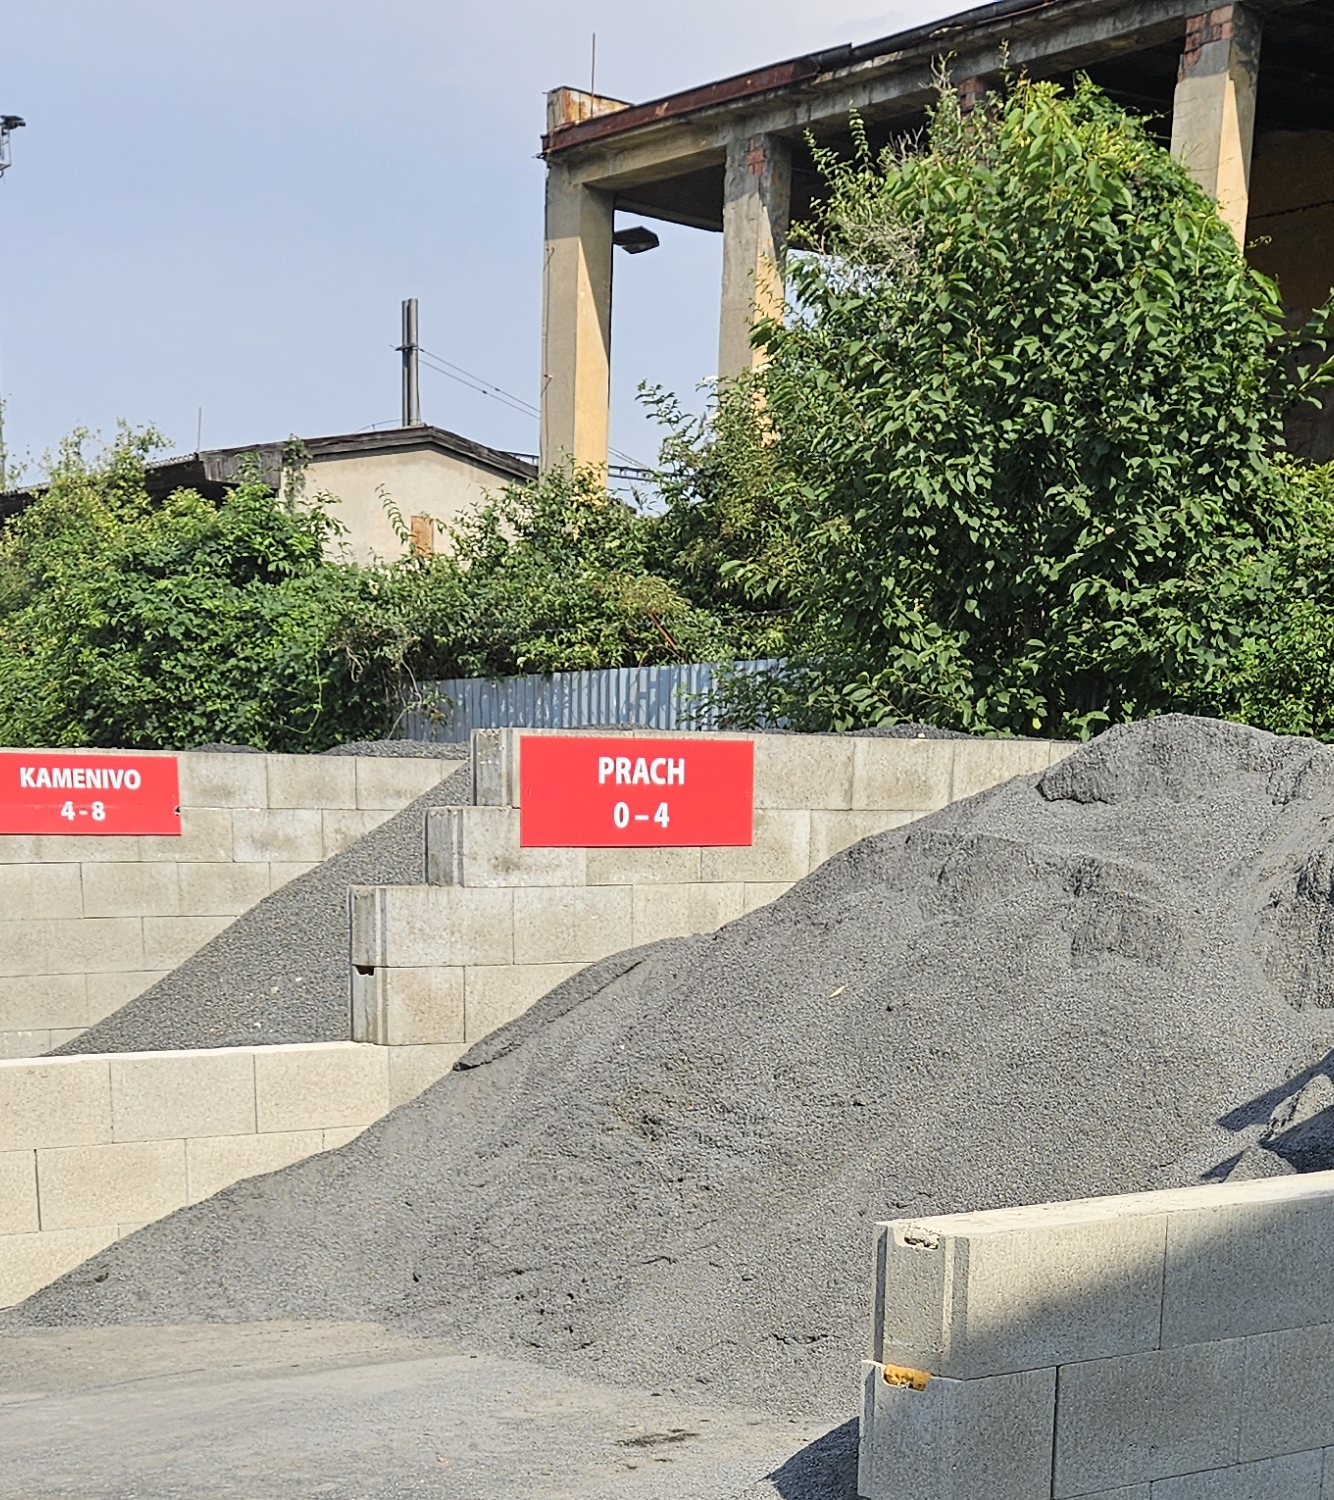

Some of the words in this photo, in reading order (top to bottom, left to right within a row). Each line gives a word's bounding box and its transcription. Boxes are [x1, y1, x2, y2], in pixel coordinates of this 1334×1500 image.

[19, 767, 142, 790] KAMENIVO
[598, 756, 686, 786] PRACH
[60, 800, 76, 821] 4
[90, 801, 106, 822] 8
[613, 801, 630, 829] 0
[653, 801, 670, 829] 4
